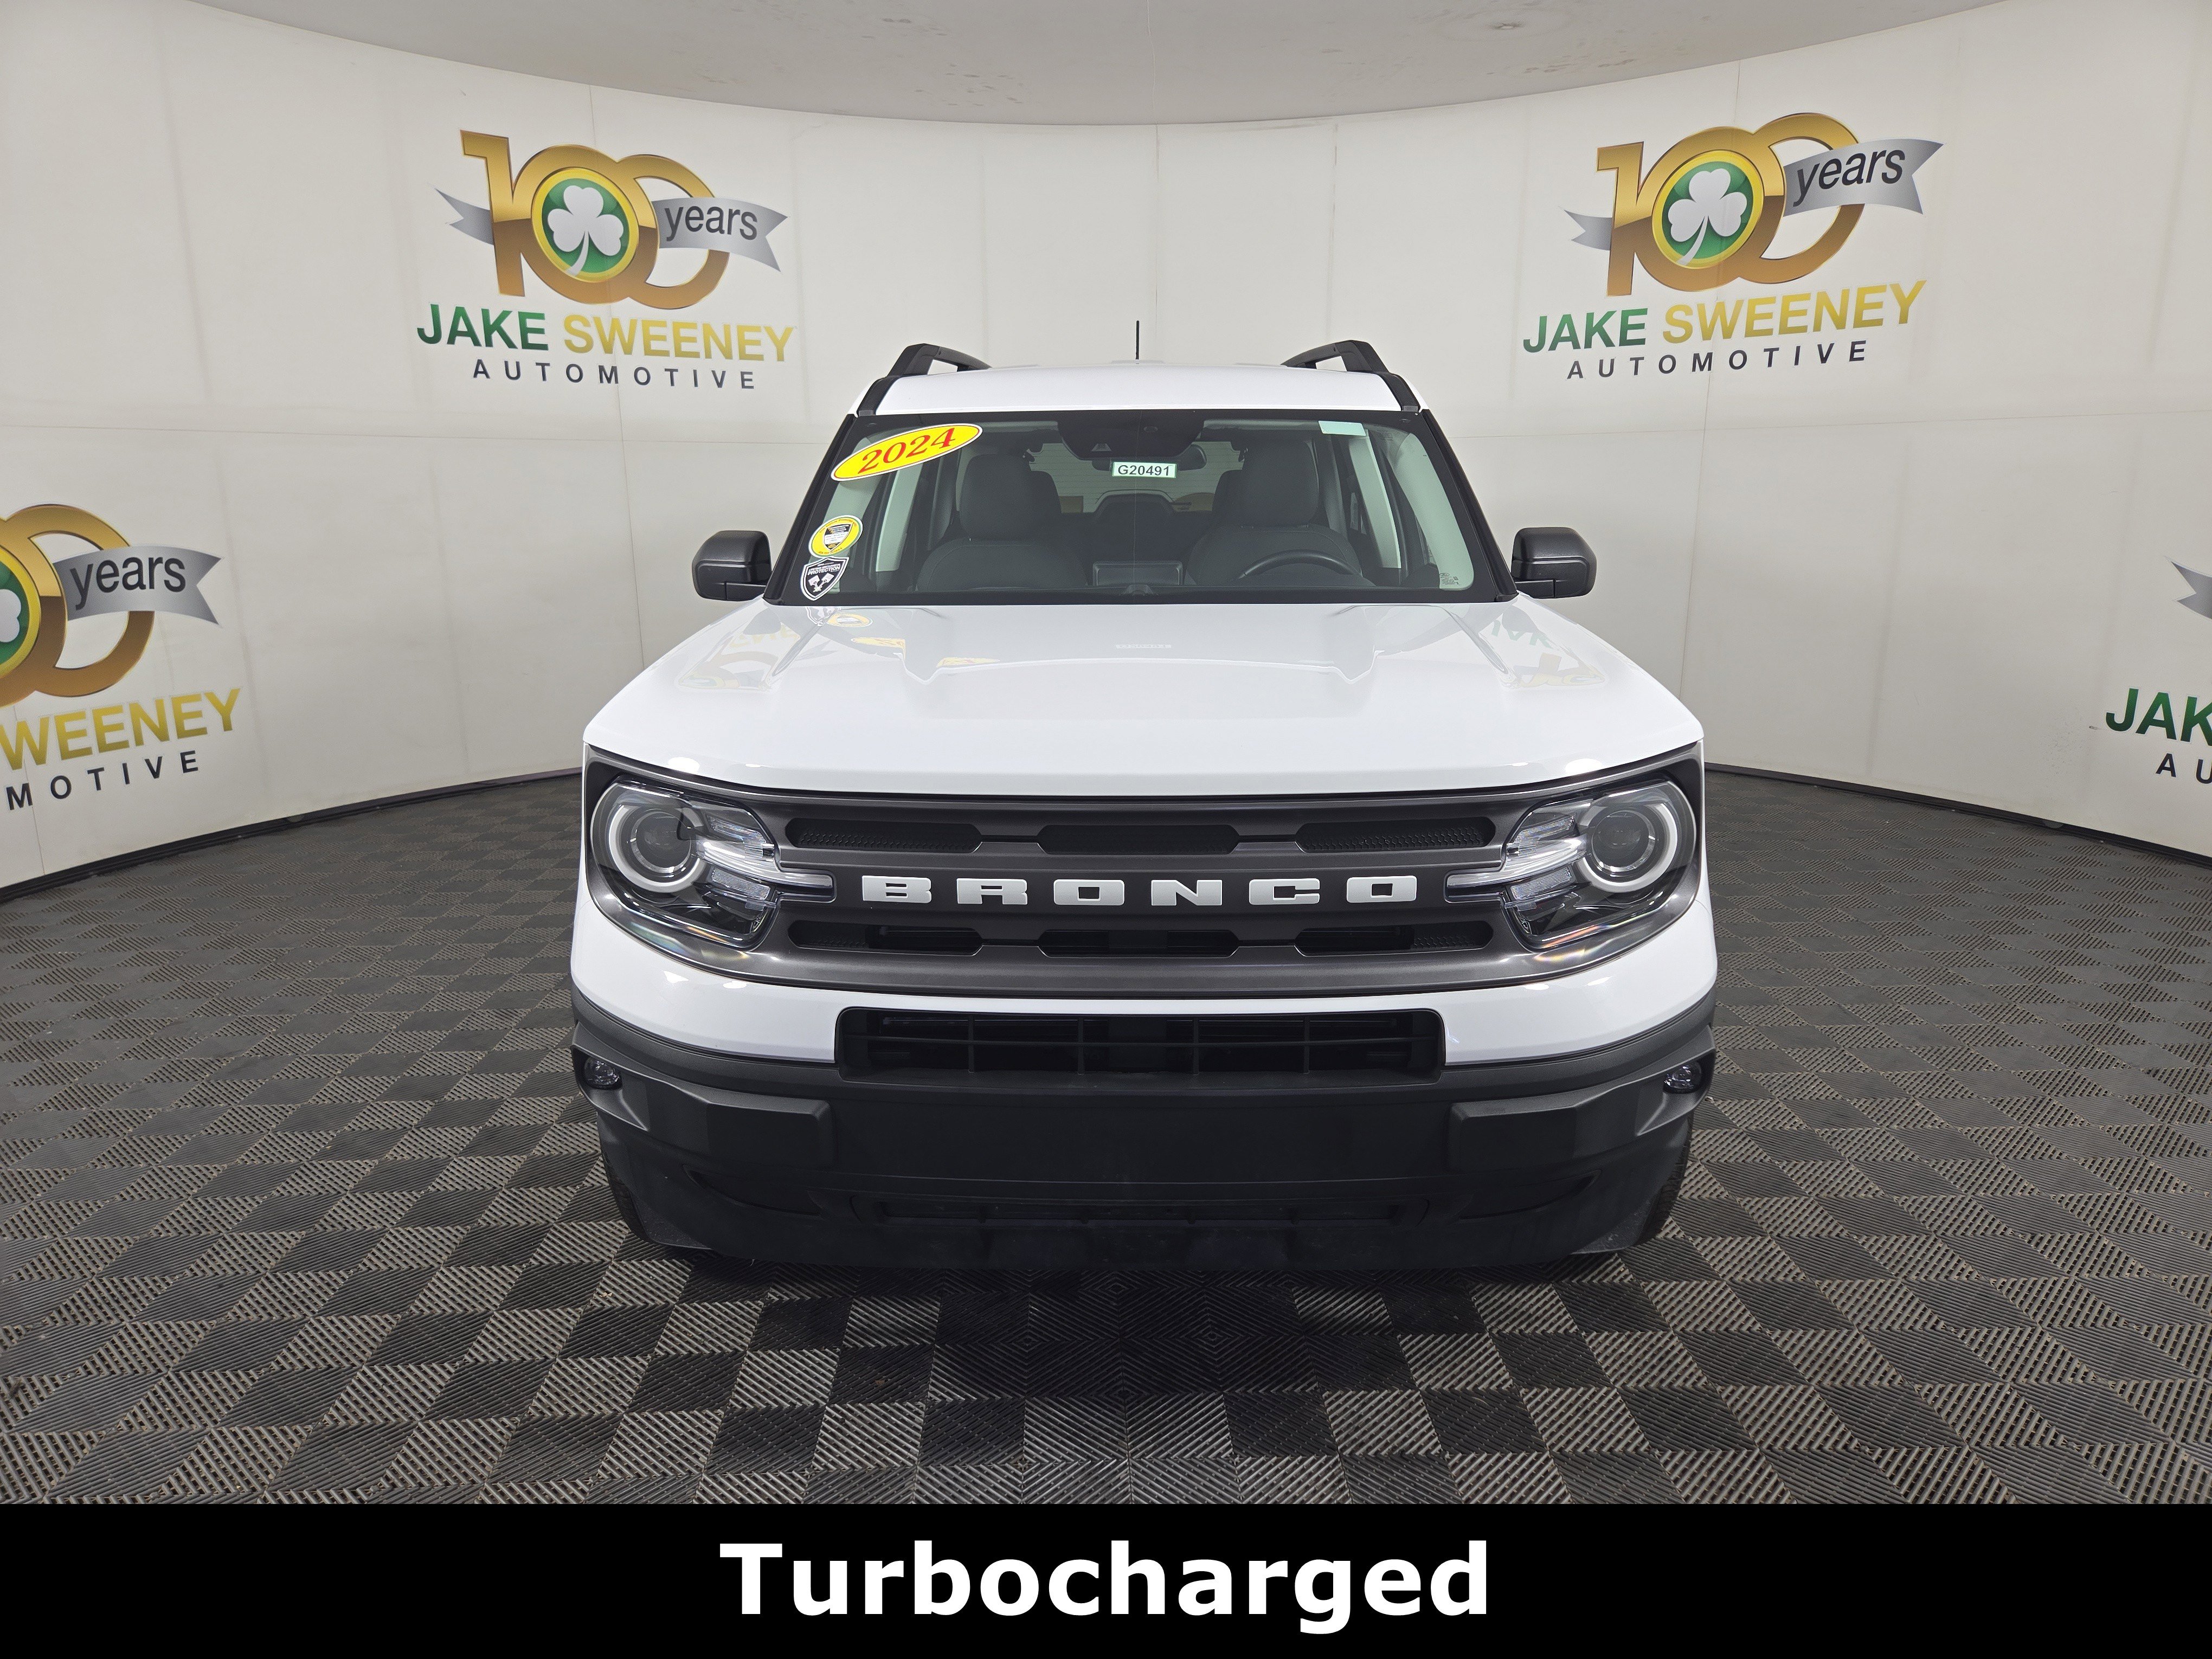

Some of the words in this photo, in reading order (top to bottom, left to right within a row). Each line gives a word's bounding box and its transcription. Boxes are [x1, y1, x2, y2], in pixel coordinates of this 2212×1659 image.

[1793, 149, 1905, 207] years
[665, 206, 758, 242] years
[417, 304, 549, 351] JAKE
[563, 314, 794, 363] SWEENEY
[1522, 307, 1649, 353] JAKE
[1662, 280, 1927, 345] SWEENEY
[472, 359, 755, 390] AUTOMOTIVE
[1566, 339, 1868, 380] AUTOMOTIVE
[858, 428, 955, 474] 2024
[1117, 465, 1169, 477] G20491
[69, 557, 187, 611] years
[861, 874, 1418, 906] BRONCO
